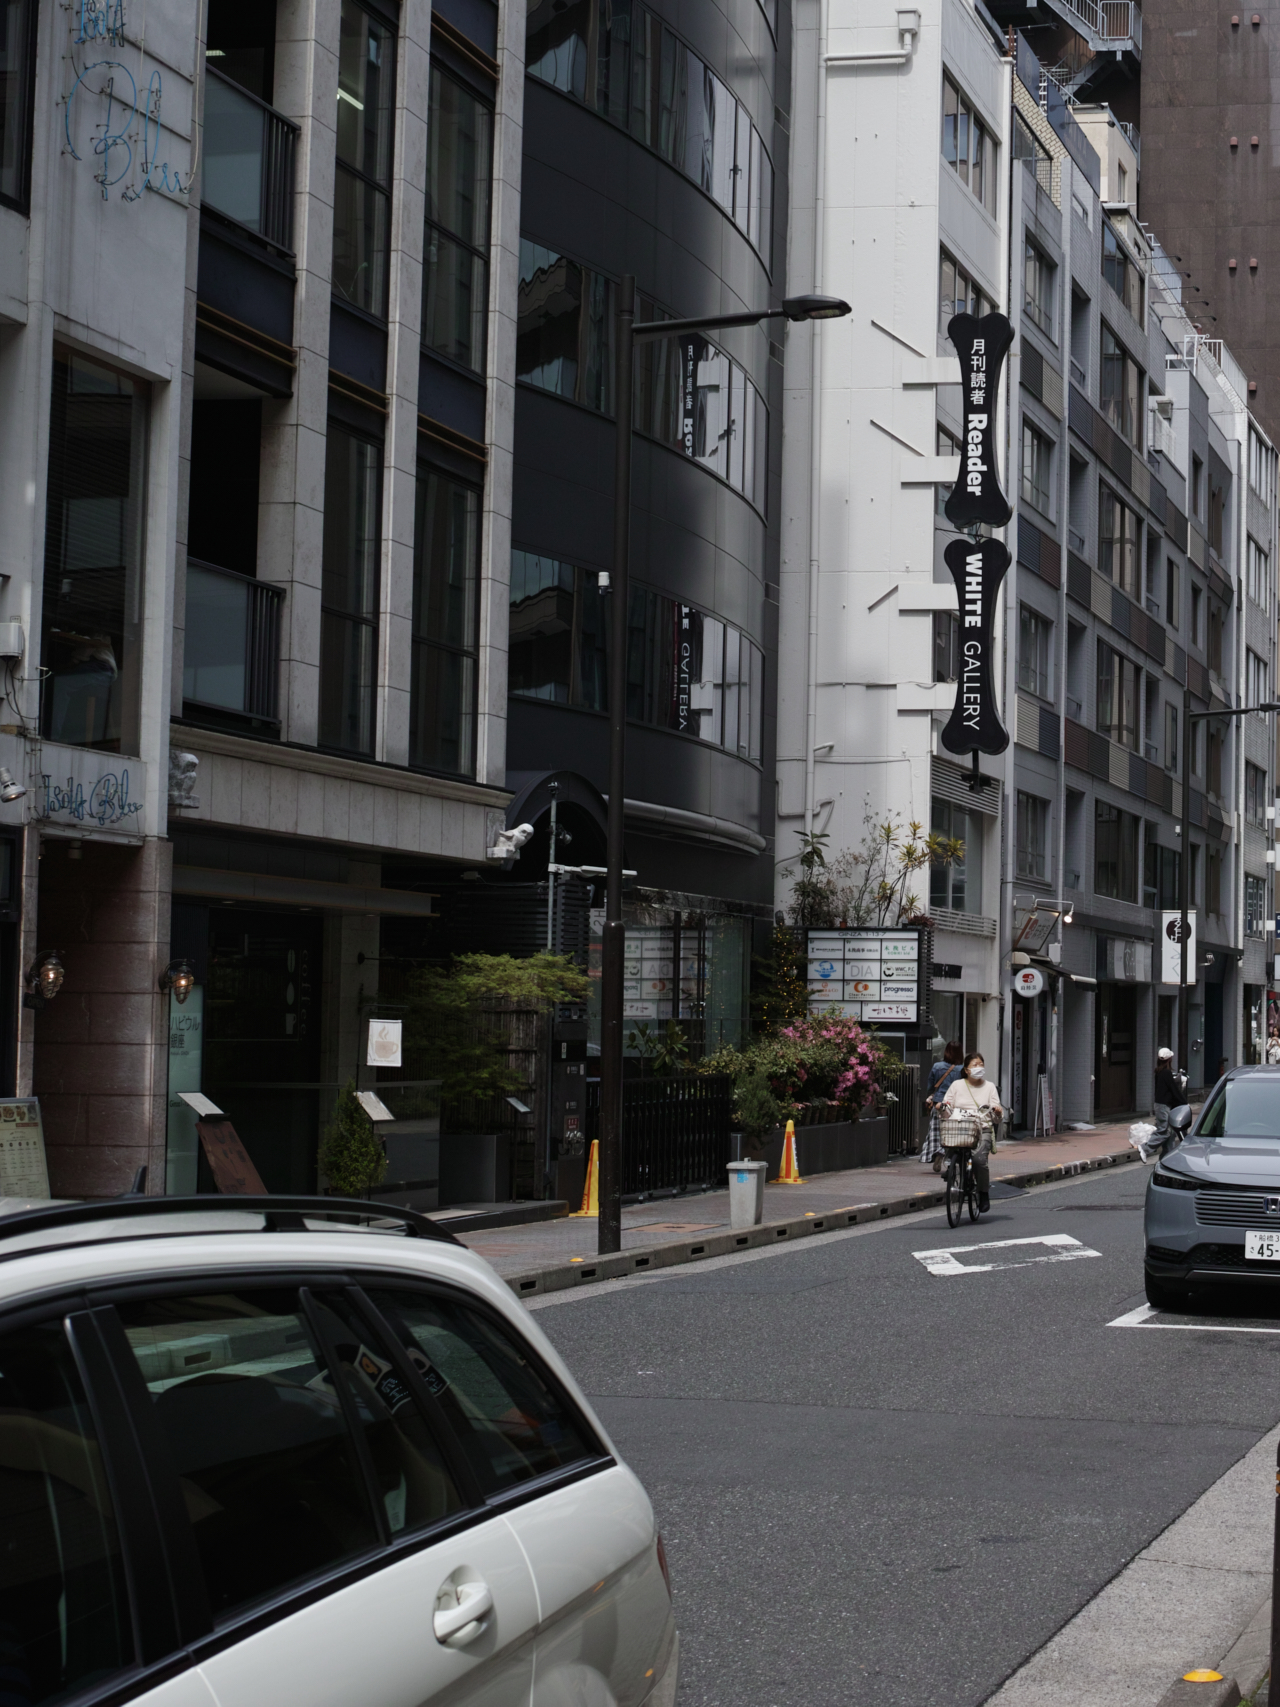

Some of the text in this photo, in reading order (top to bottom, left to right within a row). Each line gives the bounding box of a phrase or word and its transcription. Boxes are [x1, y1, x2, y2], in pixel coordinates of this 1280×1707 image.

[966, 338, 989, 497] 月刊読者 Reader
[963, 552, 984, 731] WHITE GALLERY
[850, 965, 874, 977] DIA
[884, 986, 914, 994] progresso
[170, 1033, 186, 1049] 銀座
